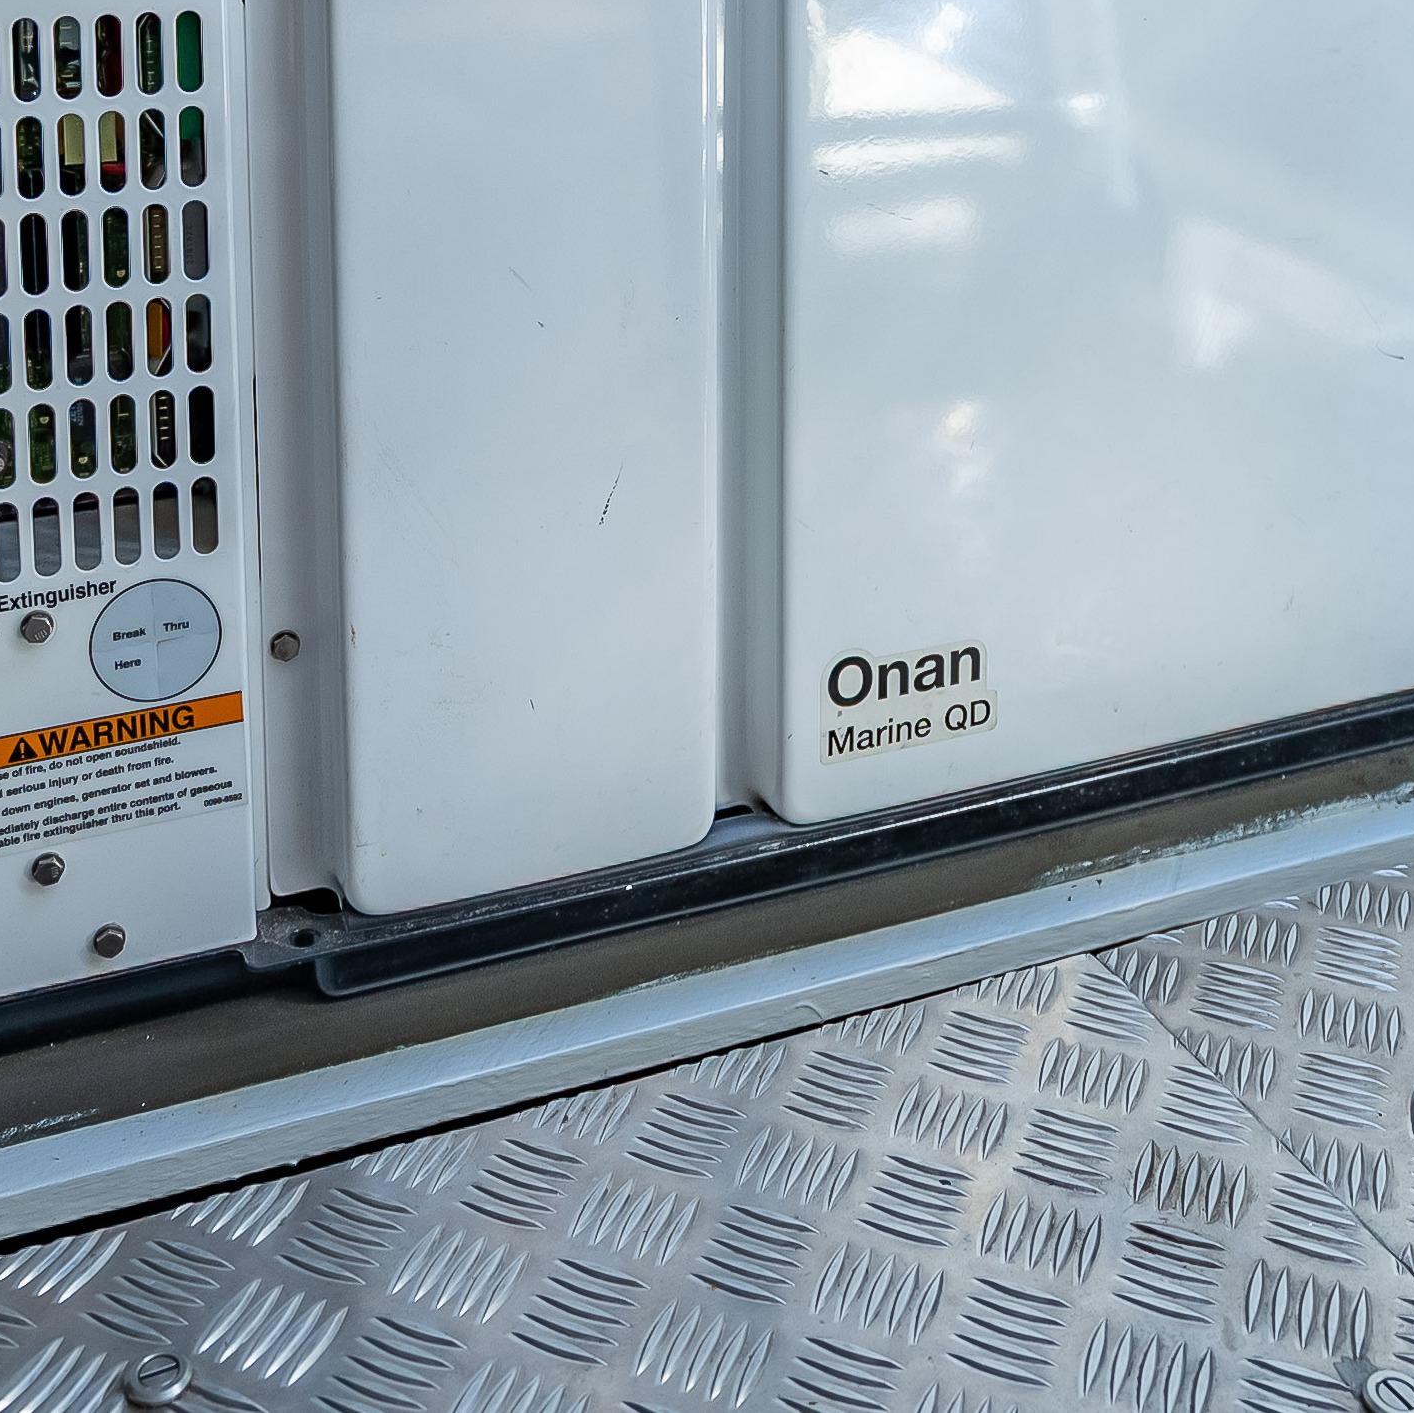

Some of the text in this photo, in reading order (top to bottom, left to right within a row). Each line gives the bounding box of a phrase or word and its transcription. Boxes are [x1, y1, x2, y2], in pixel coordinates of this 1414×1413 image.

[112, 627, 146, 641] Break
[162, 621, 189, 631] Thru
[114, 658, 141, 670] Here
[827, 646, 981, 707] Onan
[37, 705, 195, 756] WARNING
[827, 699, 991, 757] Marine QD
[5, 782, 45, 796] serious
[48, 775, 78, 788] injury
[81, 772, 93, 781] or
[94, 764, 124, 778] death
[126, 760, 151, 771] from
[153, 756, 173, 766] fire.
[11, 766, 22, 777] of
[24, 764, 46, 774] fire,
[48, 760, 63, 770] do
[65, 755, 83, 767] not
[85, 751, 112, 763] open
[114, 736, 181, 756] soundshield.
[1, 804, 30, 816] down
[33, 794, 79, 809] engines,
[81, 783, 131, 801] generator
[134, 778, 150, 788] set
[152, 772, 172, 785] and
[174, 766, 217, 780] blowers.
[41, 809, 94, 825] discharge
[97, 802, 127, 814] entire
[129, 792, 174, 807] contents
[176, 787, 187, 798] of
[189, 780, 232, 797] gaseous
[22, 832, 40, 842] fire
[42, 817, 109, 837] extinguisher
[110, 812, 132, 823] thru
[134, 807, 154, 818] this
[157, 801, 181, 815] port.
